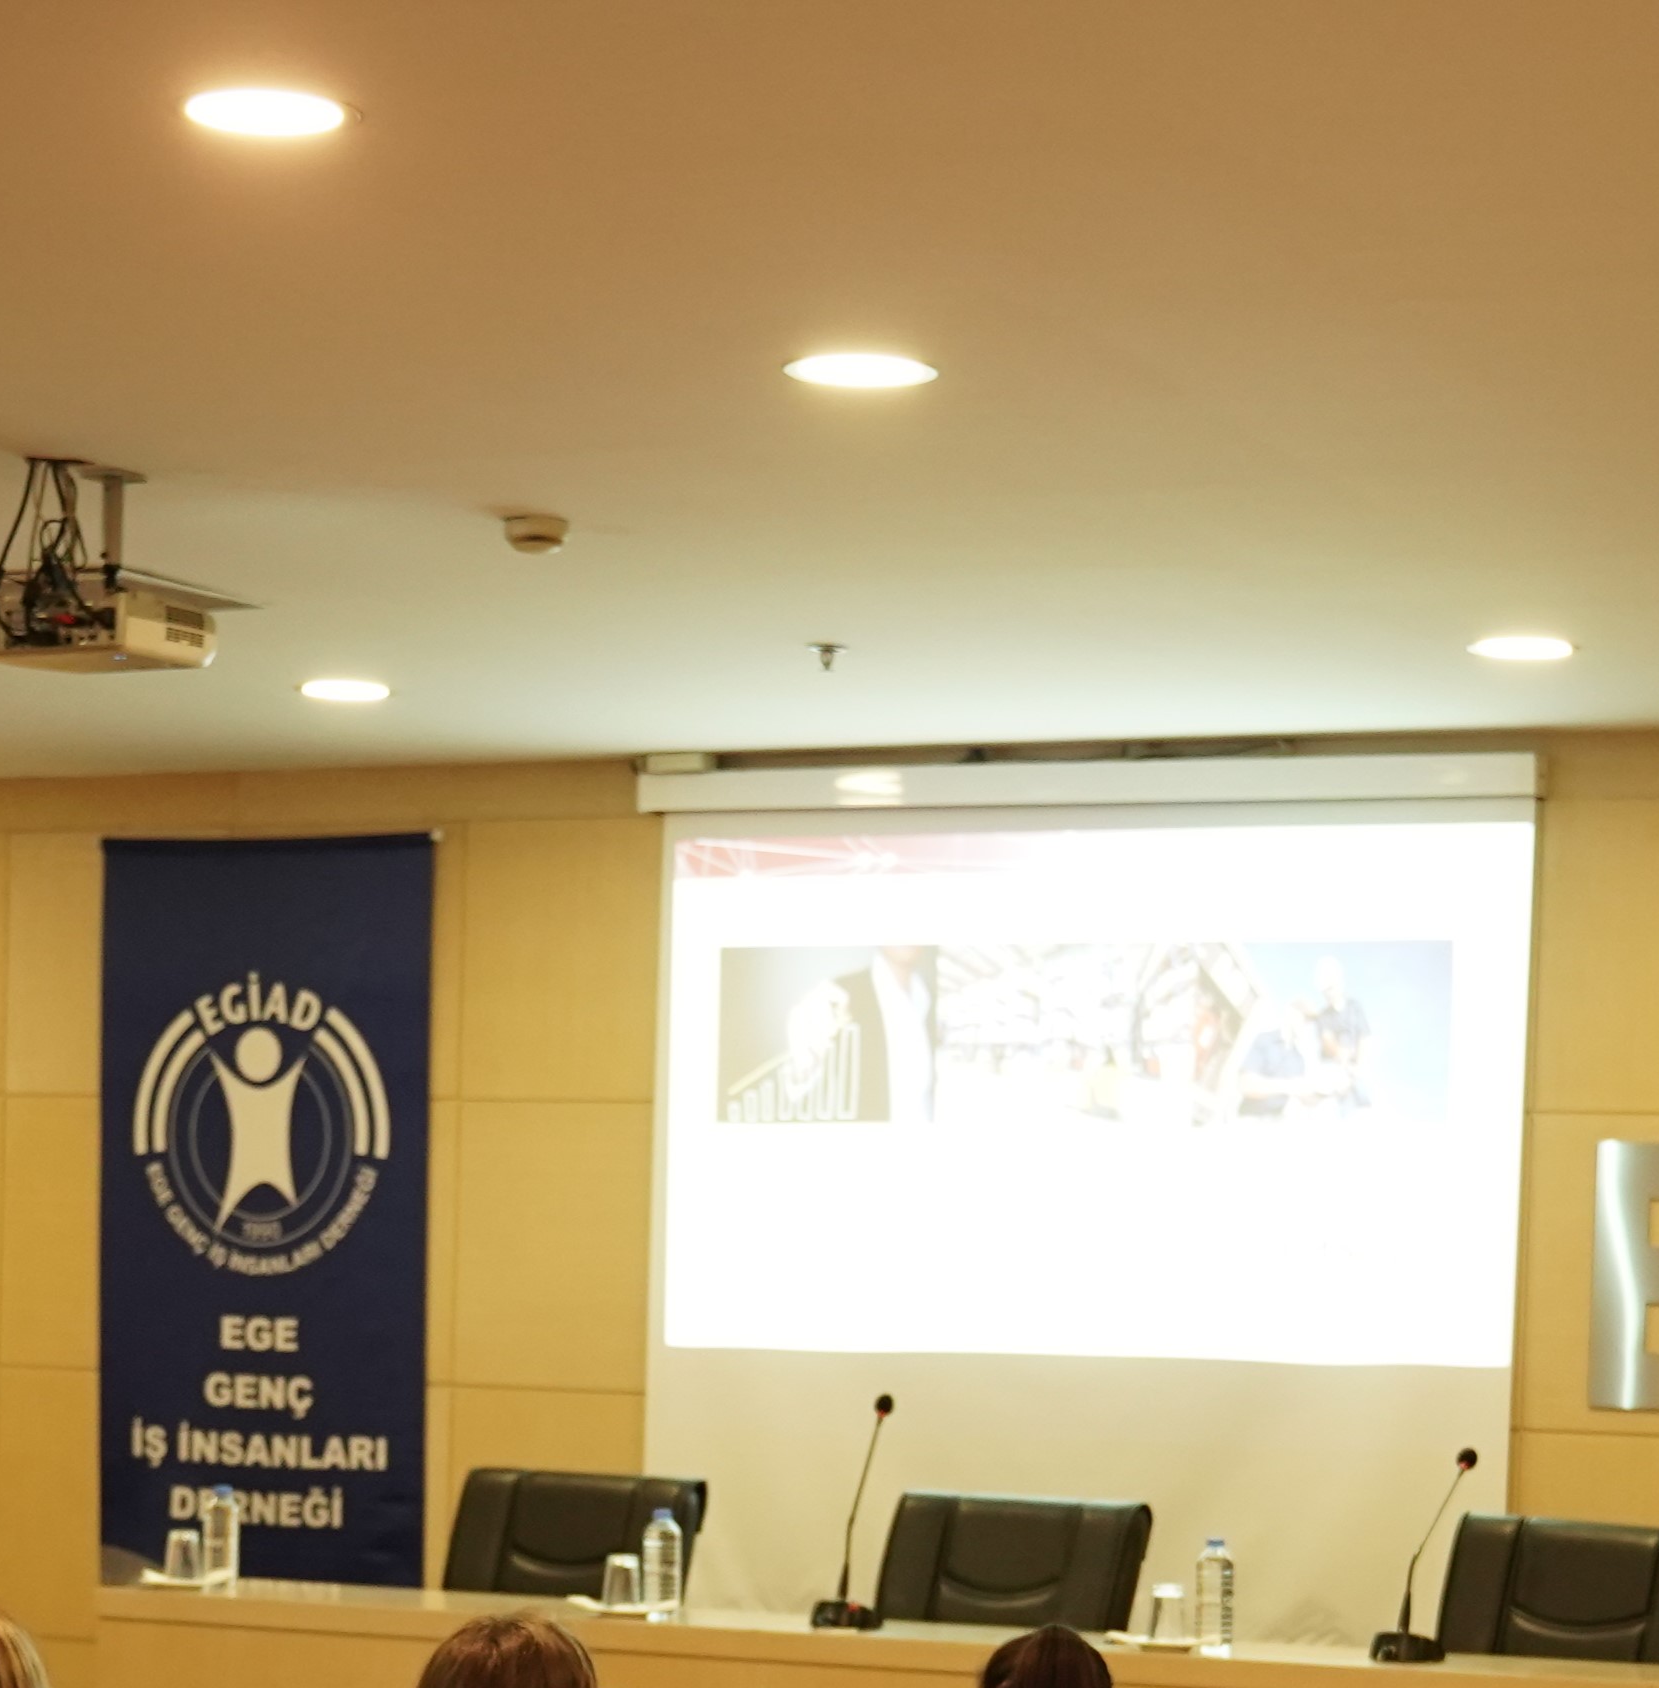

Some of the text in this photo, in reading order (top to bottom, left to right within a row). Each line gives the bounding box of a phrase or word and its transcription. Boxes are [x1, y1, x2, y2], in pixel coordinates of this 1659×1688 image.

[194, 970, 322, 1037] EGİAD
[219, 1314, 300, 1352] EGE
[203, 1370, 314, 1420] GENÇ
[130, 1415, 388, 1471] İŞ İNSANLARI
